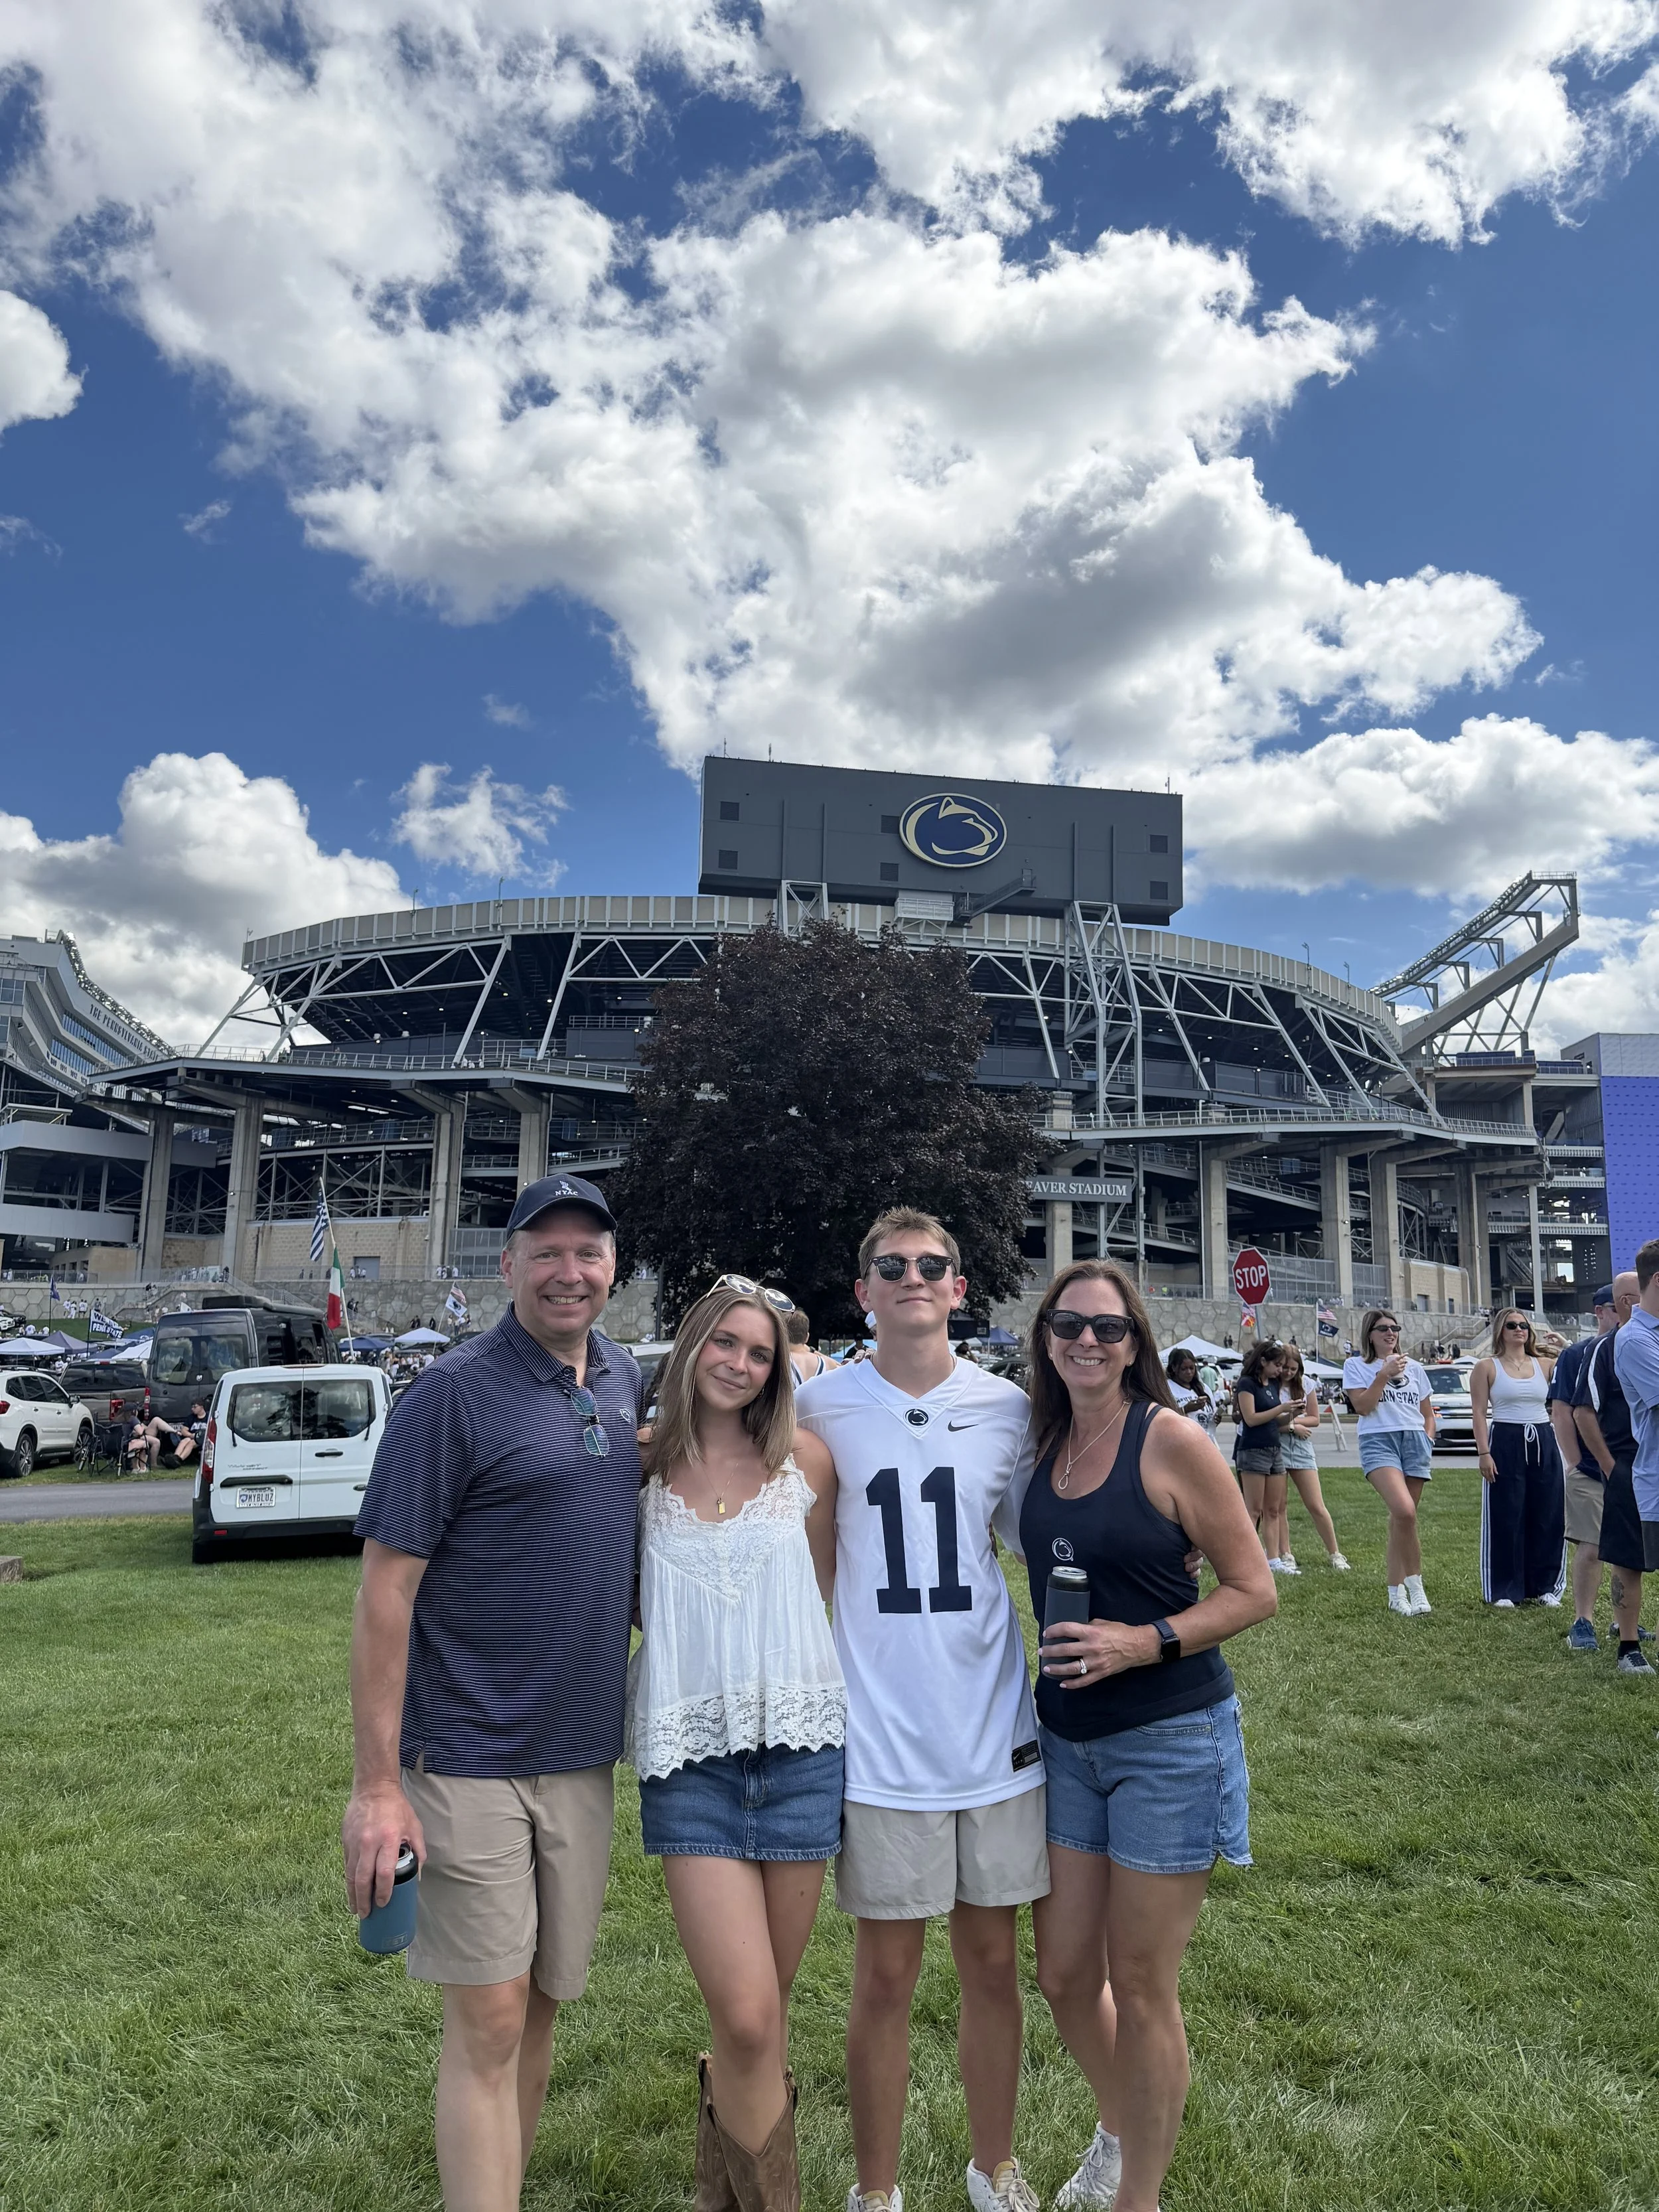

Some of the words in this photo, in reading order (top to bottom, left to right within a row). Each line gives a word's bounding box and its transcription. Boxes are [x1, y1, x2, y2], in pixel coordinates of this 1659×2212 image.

[90, 1003, 101, 1021] THE
[103, 1014, 143, 1052] PENNSYLVANIA
[1018, 1181, 1066, 1193] EAVER
[1069, 1183, 1127, 1196] STADIUM
[1235, 1265, 1267, 1290] STOP
[92, 1323, 106, 1333] PENN
[106, 1327, 123, 1339] STATE
[1378, 1390, 1396, 1402] NN
[865, 1467, 973, 1614] 11
